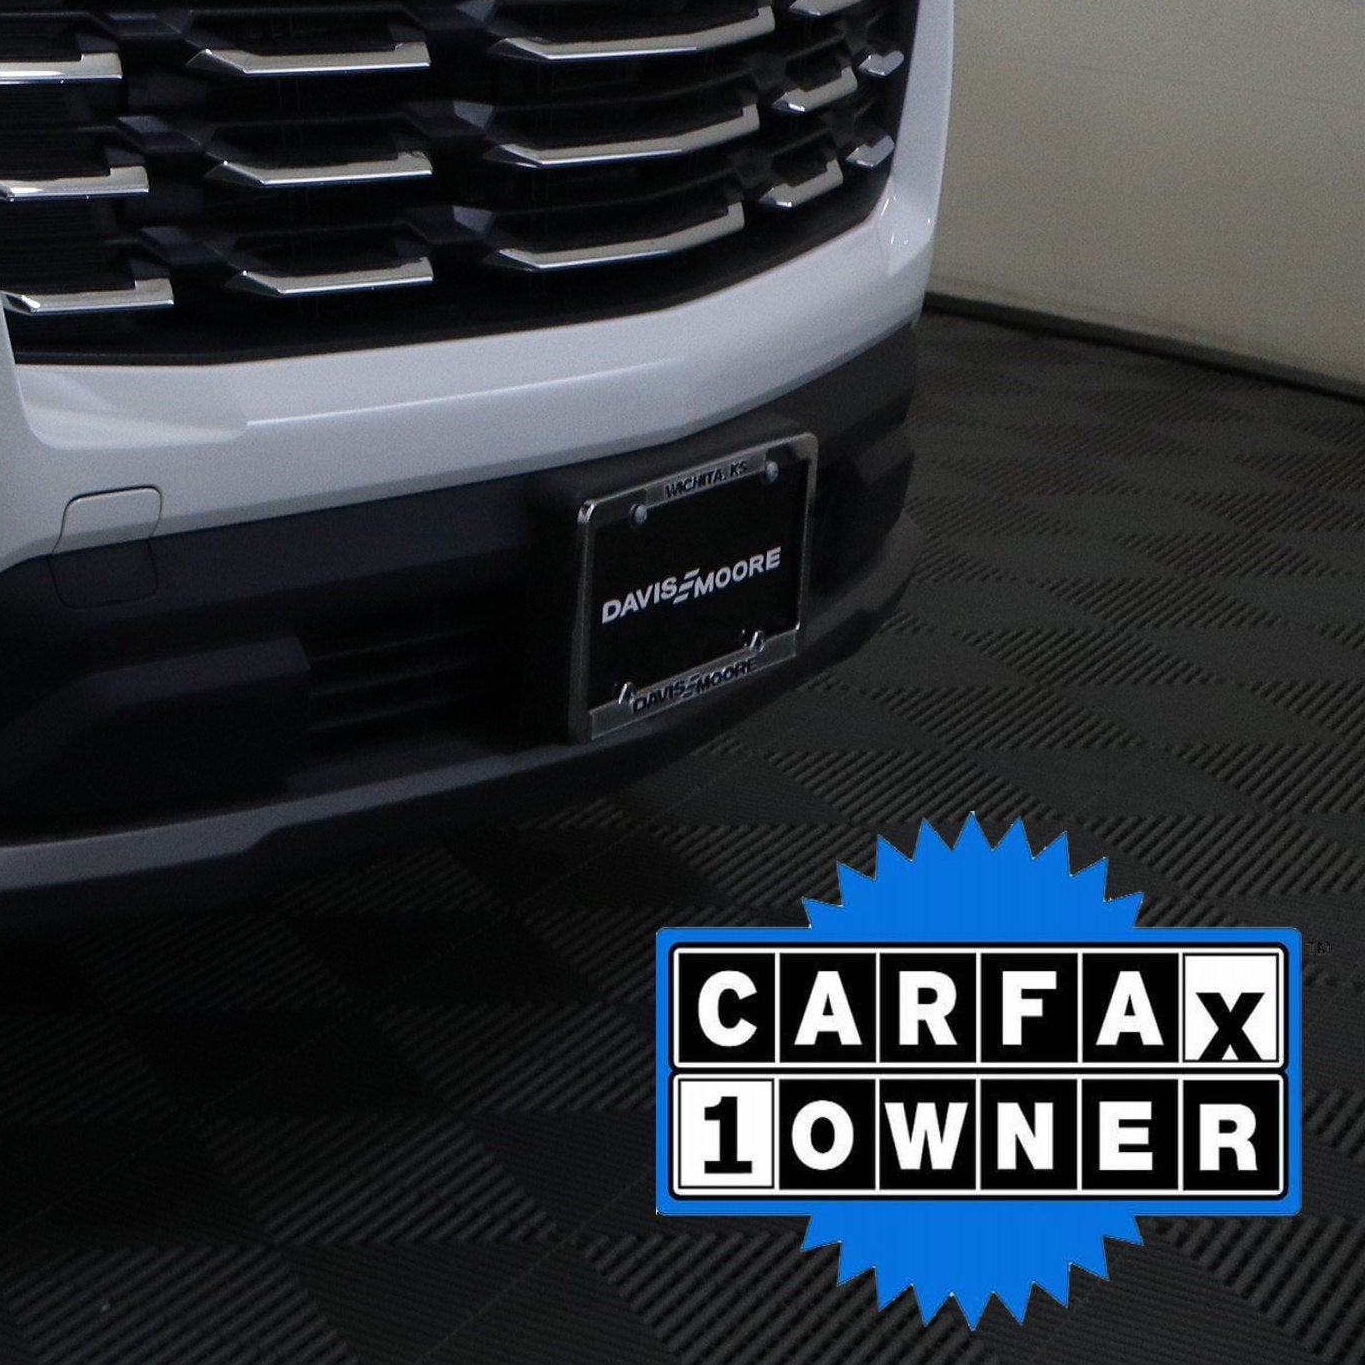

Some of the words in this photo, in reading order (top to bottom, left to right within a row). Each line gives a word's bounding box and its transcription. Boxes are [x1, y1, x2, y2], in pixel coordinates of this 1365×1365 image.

[730, 460, 748, 478] KS
[601, 576, 677, 624] DAVIS
[694, 546, 781, 598] MOORE
[632, 678, 689, 714] DAVIS
[697, 655, 758, 693] MOORE
